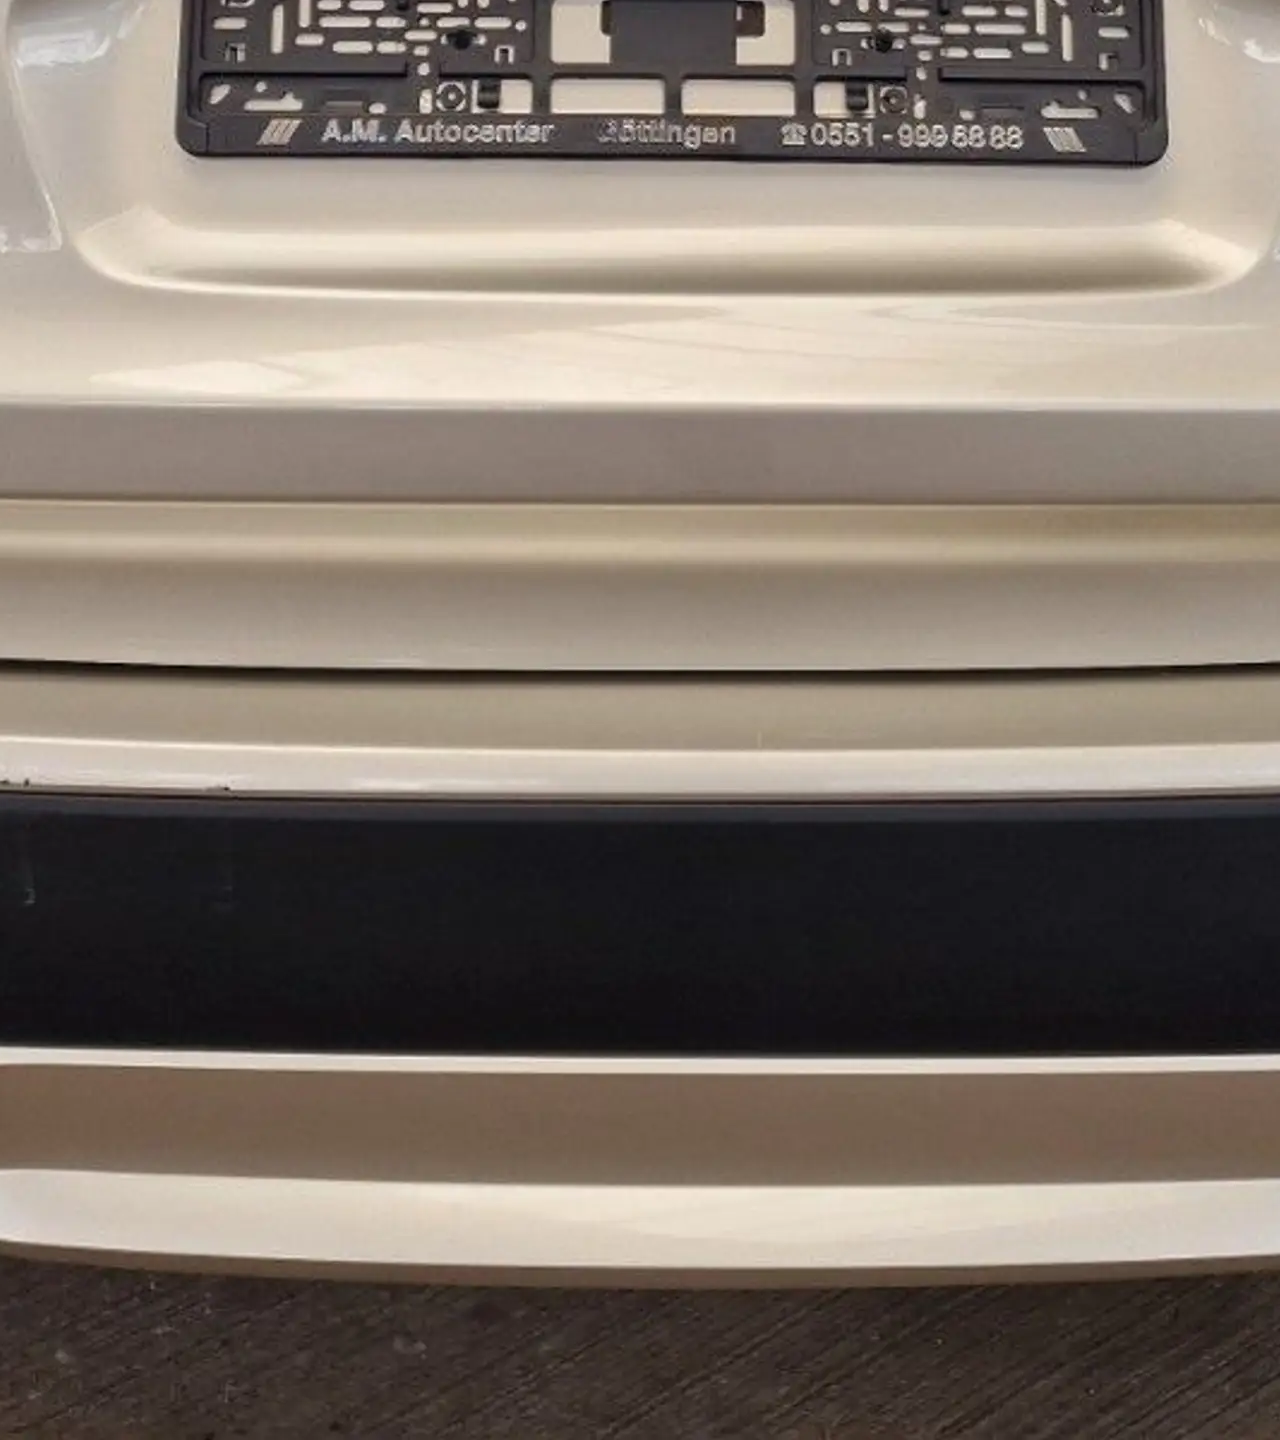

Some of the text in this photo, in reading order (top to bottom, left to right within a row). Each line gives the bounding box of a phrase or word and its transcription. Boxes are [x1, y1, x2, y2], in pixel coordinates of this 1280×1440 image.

[321, 118, 386, 144] A.M.
[394, 118, 555, 145] Autocenter
[810, 122, 874, 147] 0551
